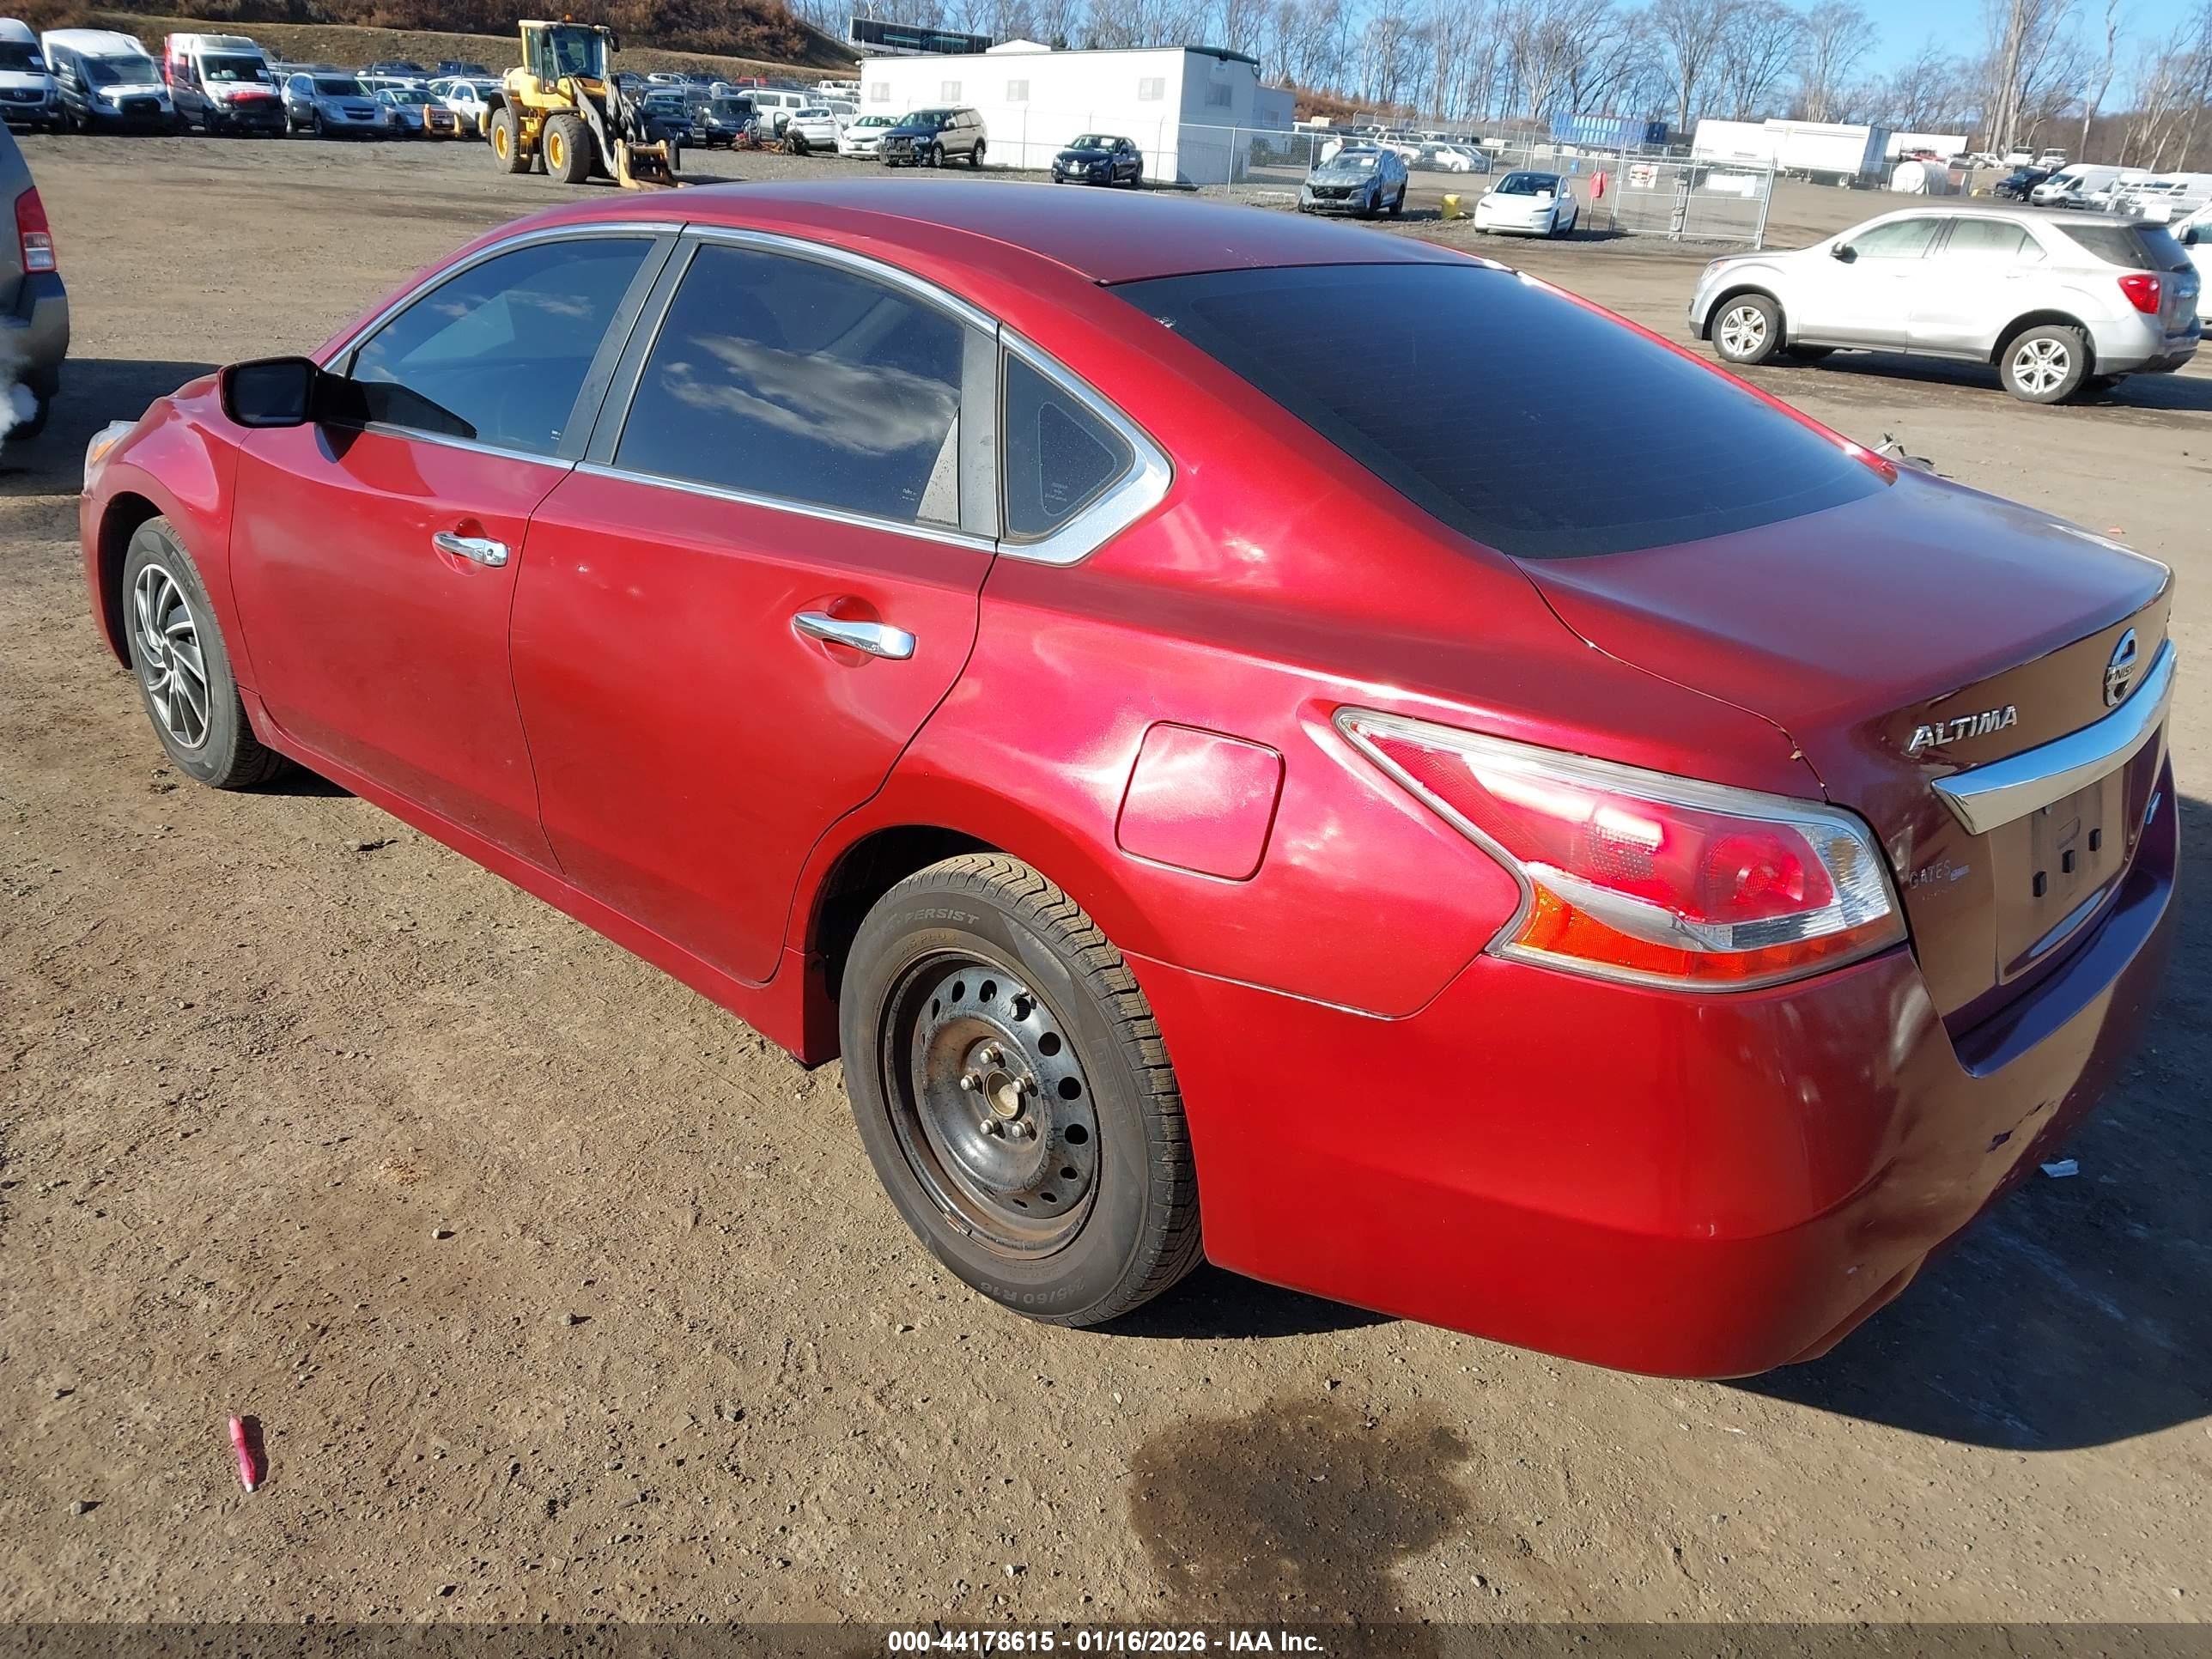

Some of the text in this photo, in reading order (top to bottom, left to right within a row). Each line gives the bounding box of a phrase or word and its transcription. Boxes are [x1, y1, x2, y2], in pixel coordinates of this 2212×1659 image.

[1908, 705, 2019, 752] ALTIMA
[1909, 858, 1951, 890] GATES
[904, 908, 981, 926] PERSIST
